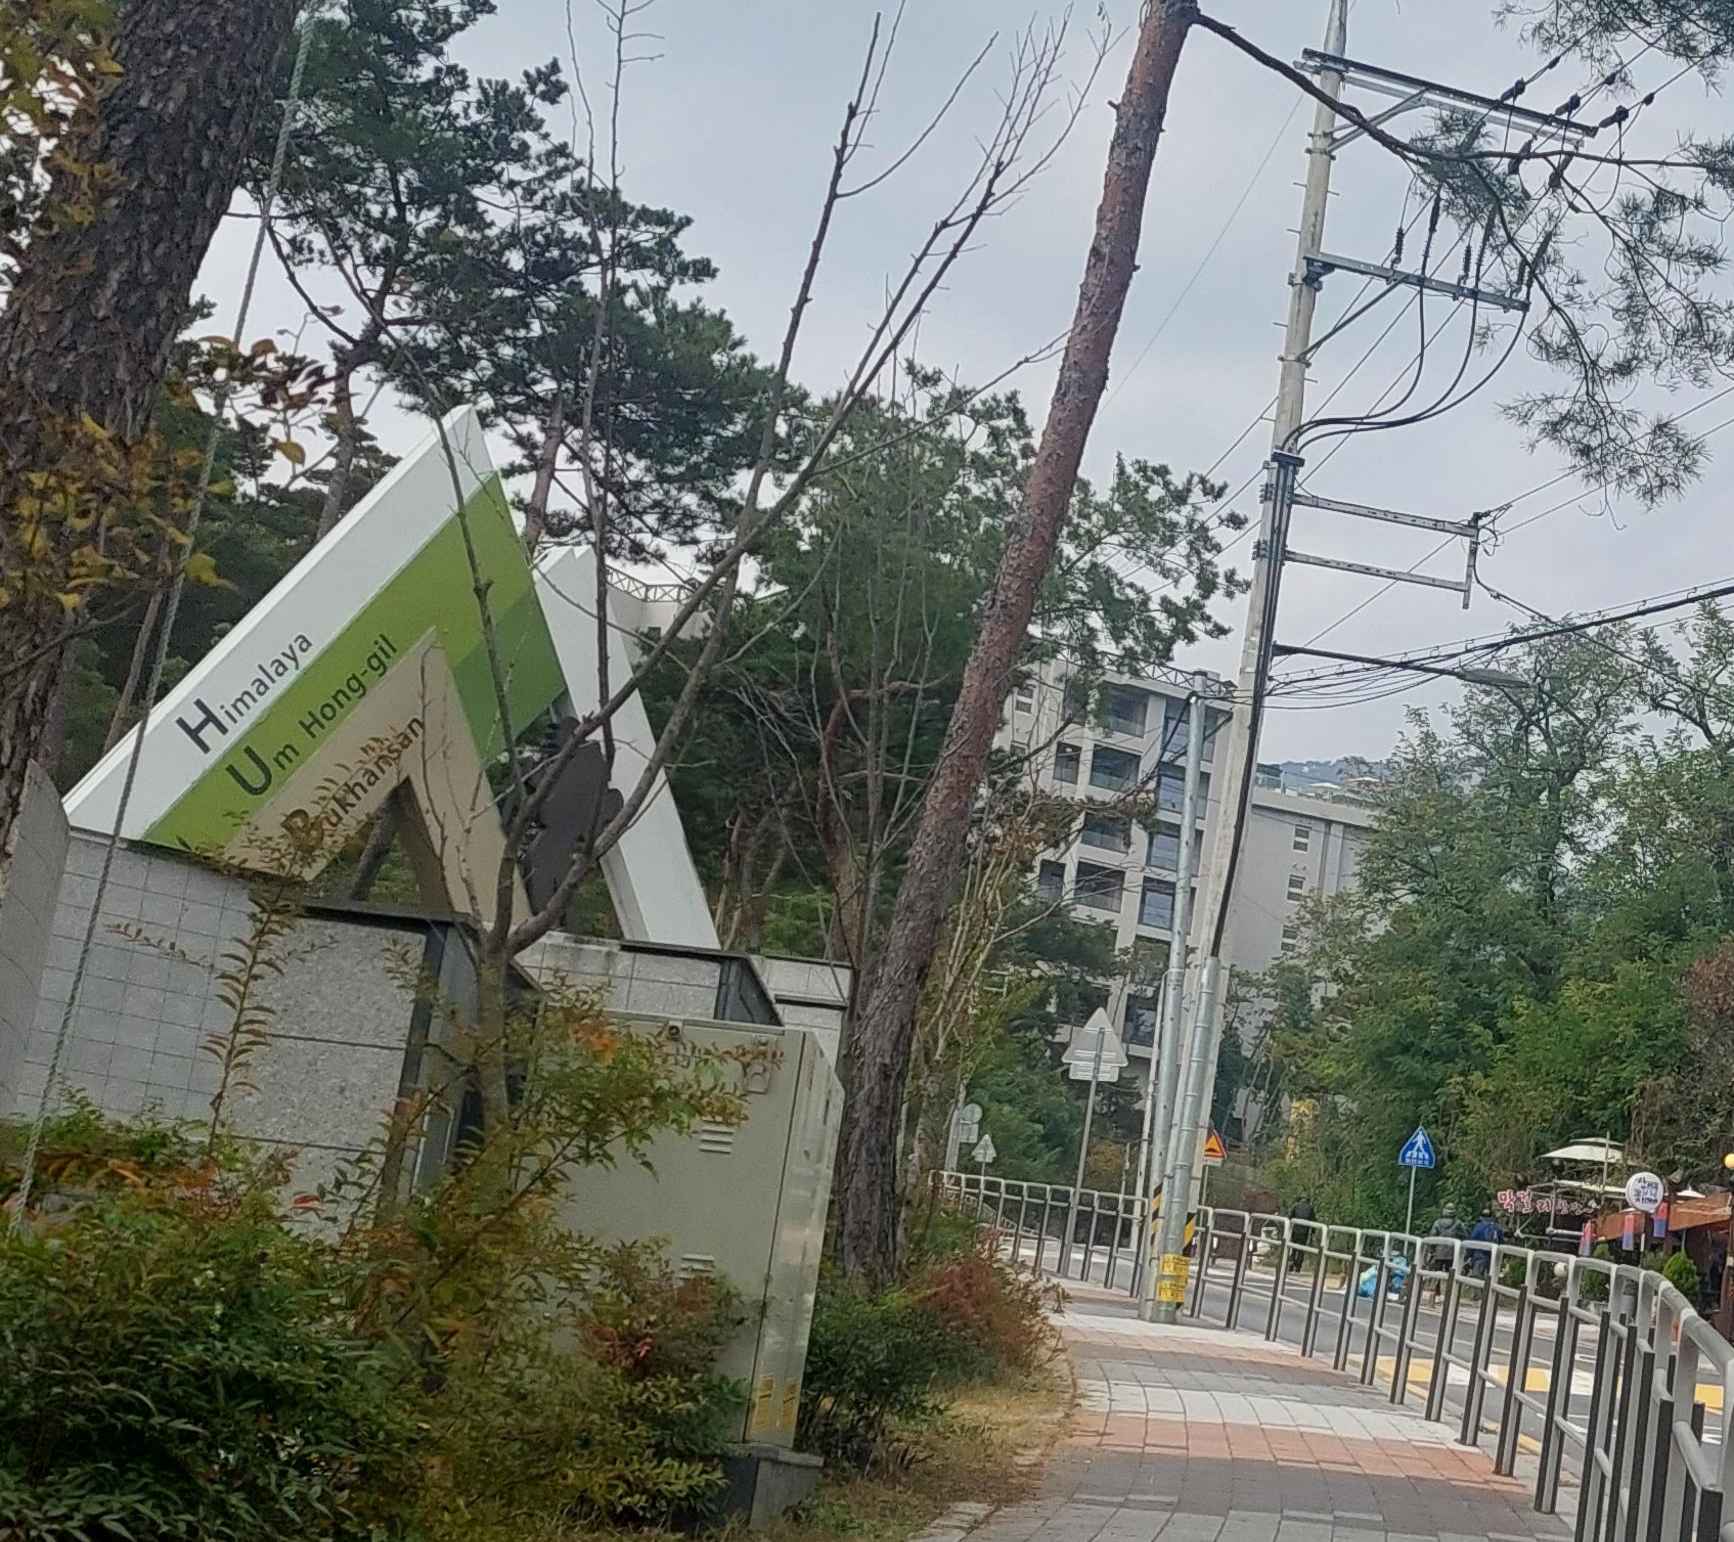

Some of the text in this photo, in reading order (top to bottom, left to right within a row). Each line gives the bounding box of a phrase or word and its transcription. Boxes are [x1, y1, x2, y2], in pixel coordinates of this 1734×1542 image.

[175, 633, 313, 755] Himalaya
[225, 633, 398, 796] Um Hong-gil
[280, 716, 425, 852] Bukhansan
[1498, 1190, 1551, 1213] 막걸리
